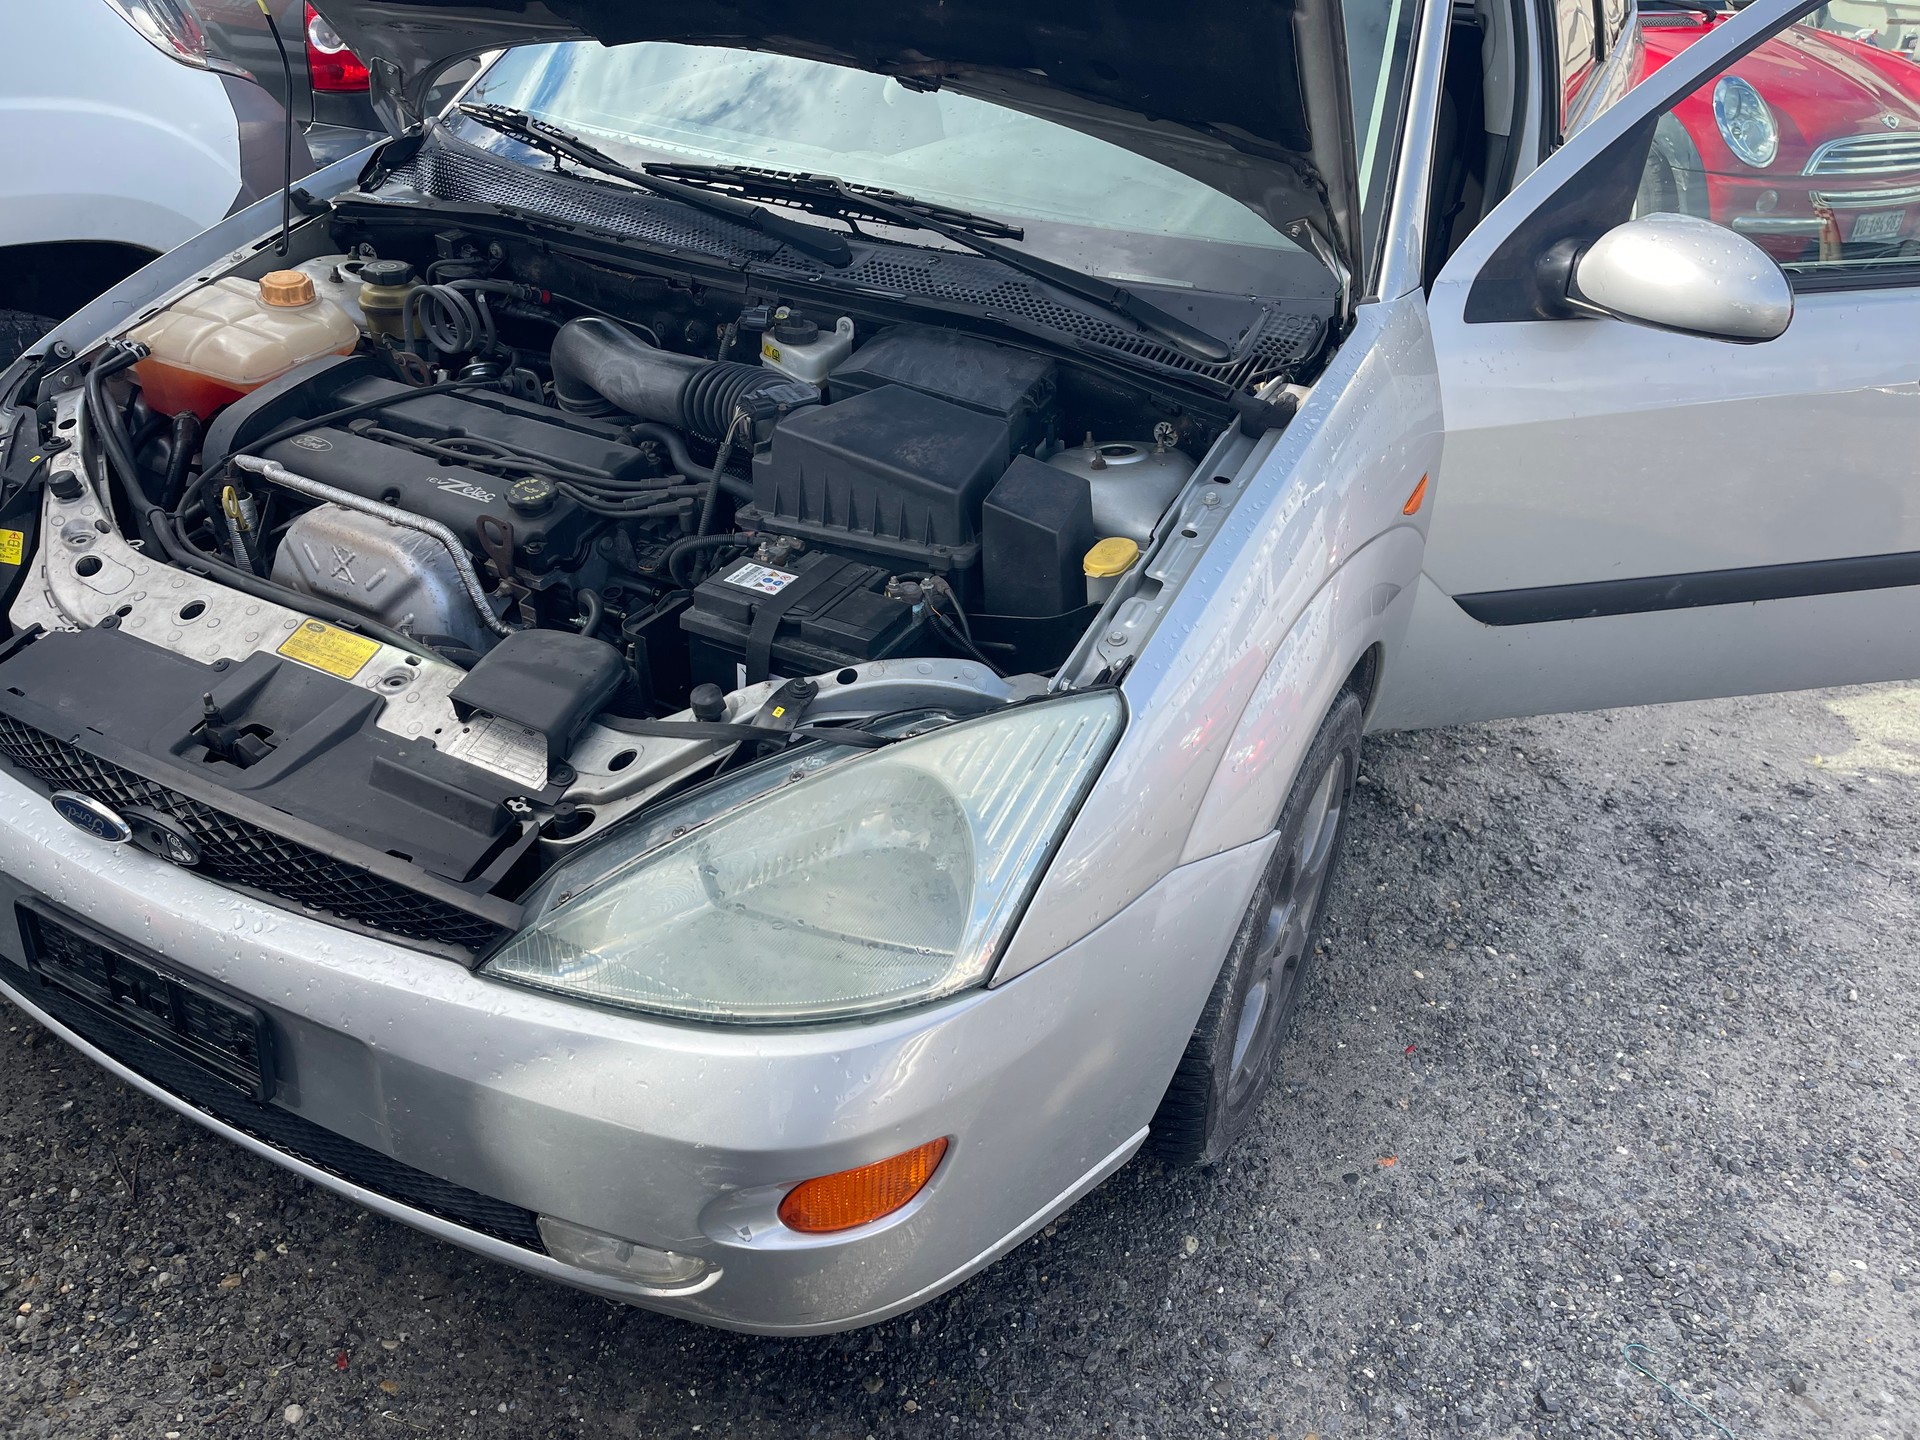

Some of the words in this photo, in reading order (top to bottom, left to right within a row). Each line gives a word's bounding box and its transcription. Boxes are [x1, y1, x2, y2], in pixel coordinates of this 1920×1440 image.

[296, 435, 327, 450] Ford
[437, 478, 496, 503] Zetec
[522, 727, 536, 737] FORD
[65, 803, 105, 837] Ford
